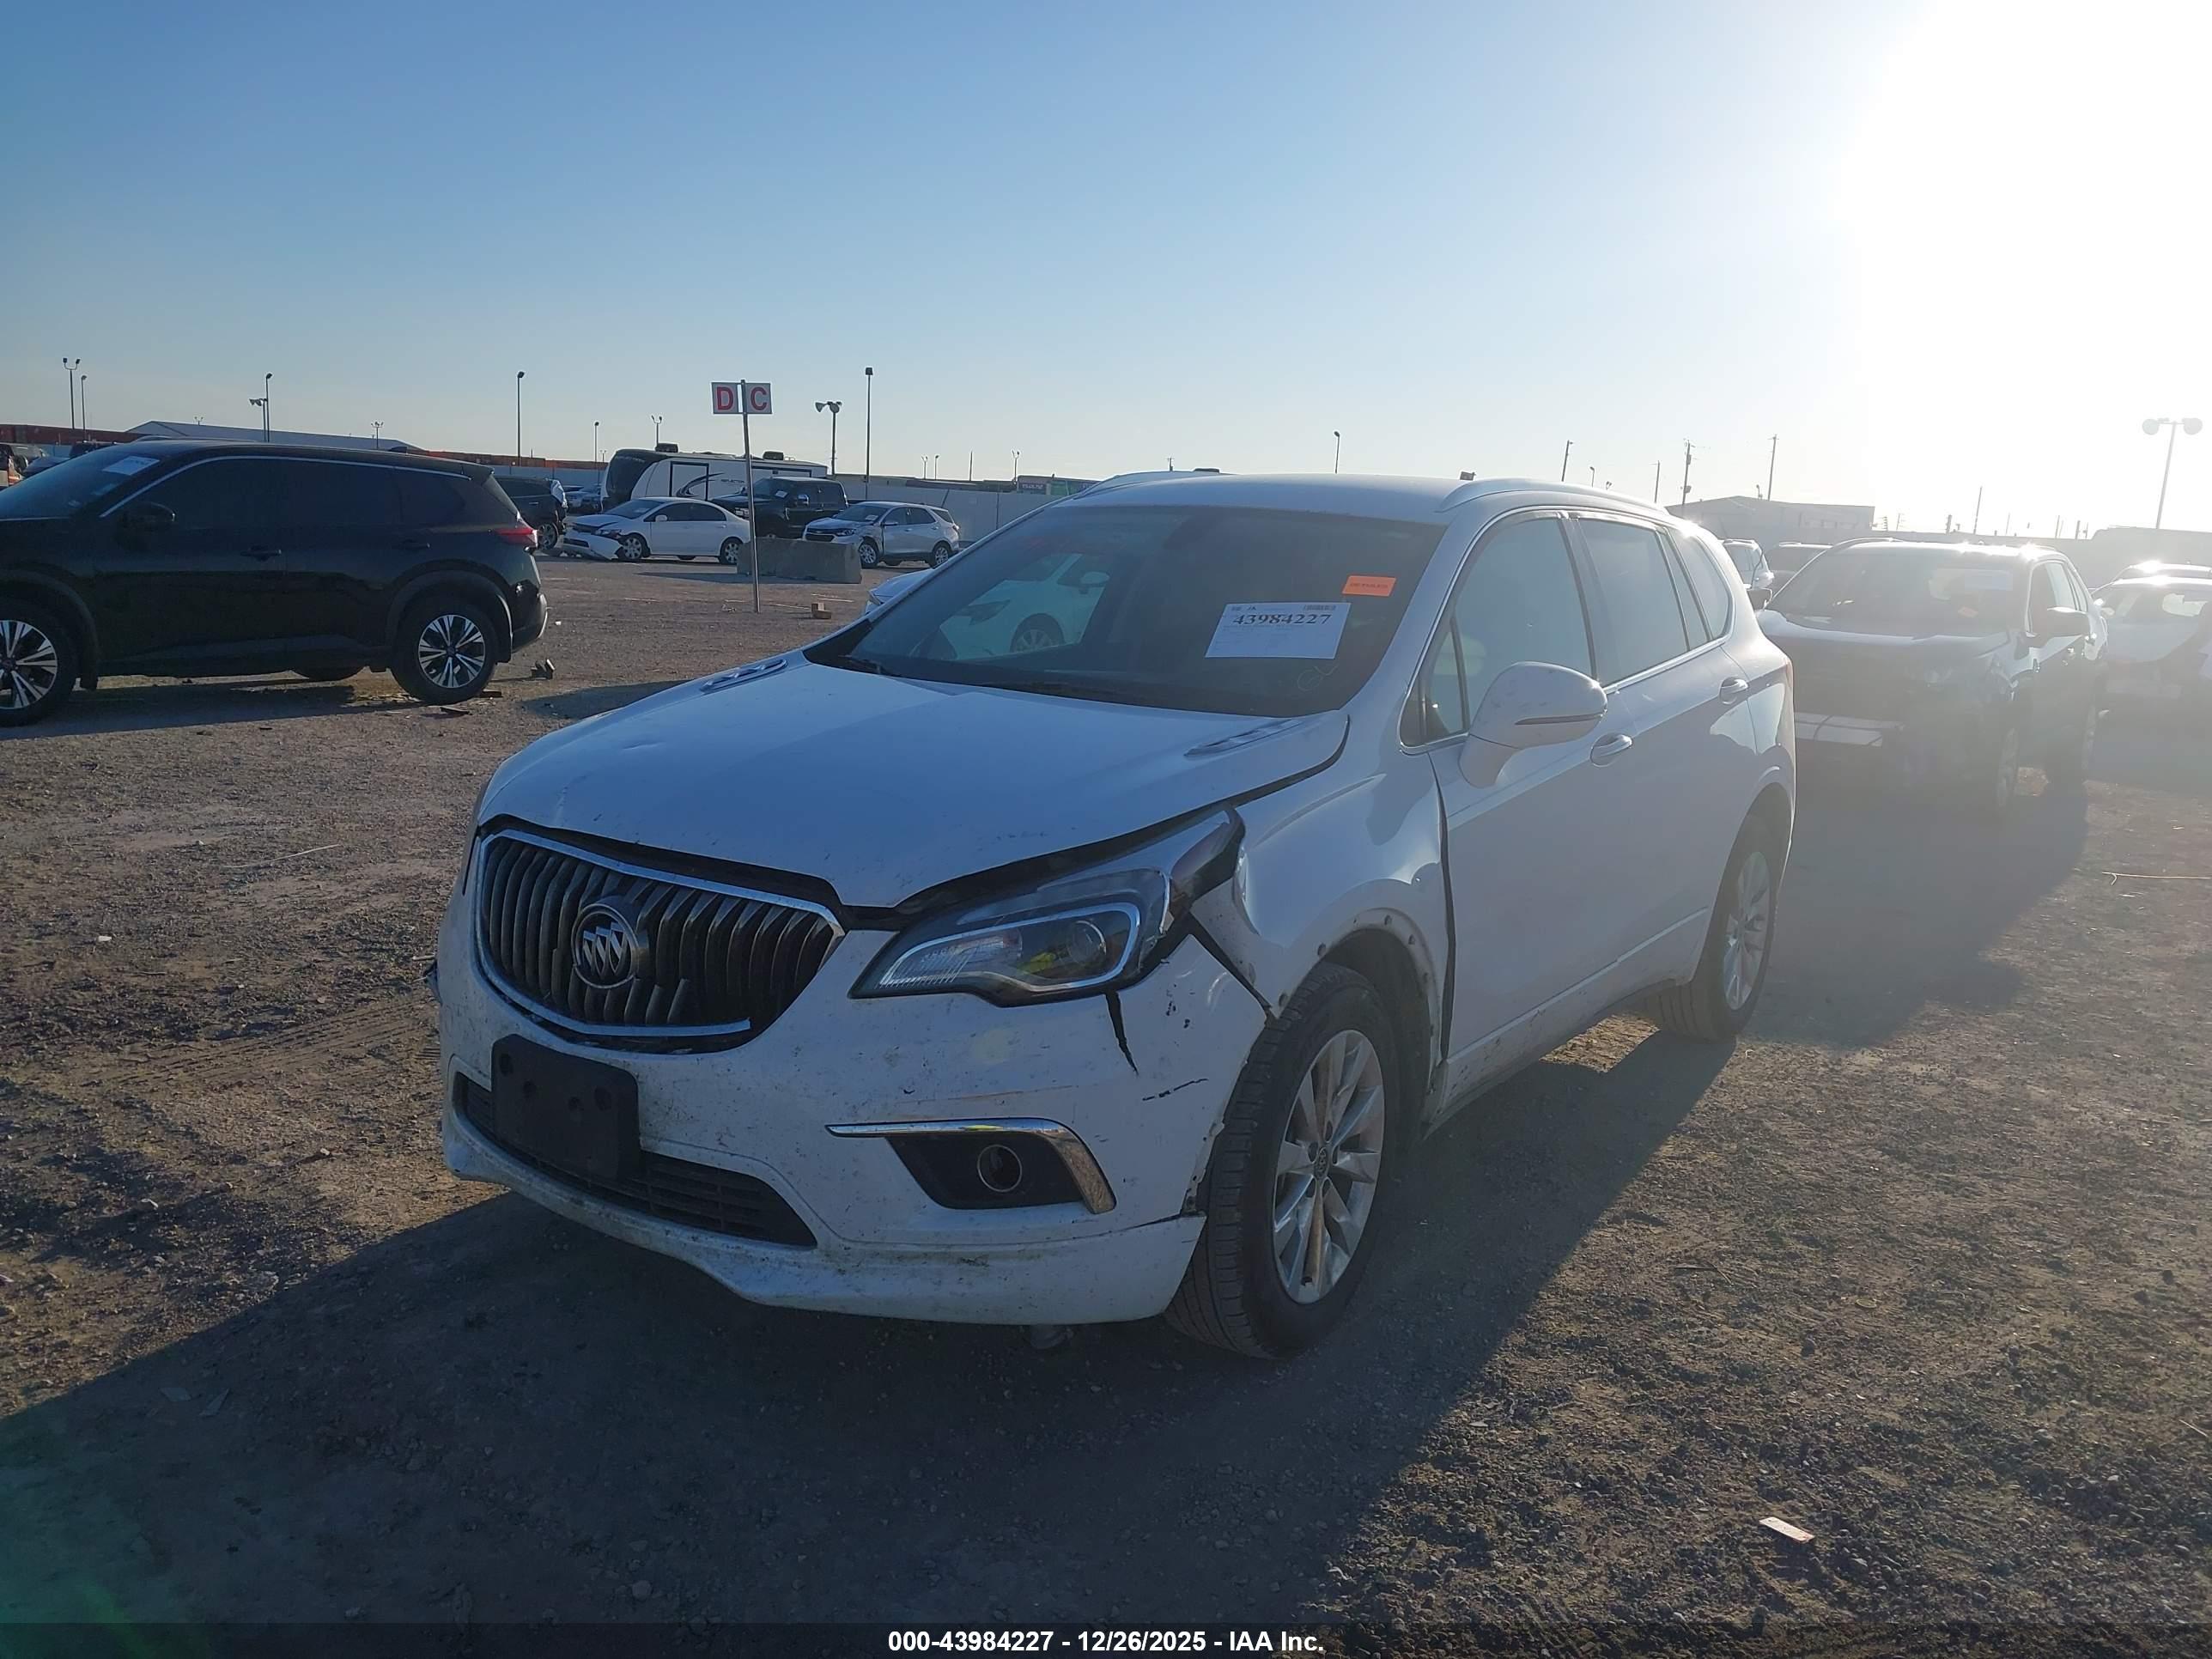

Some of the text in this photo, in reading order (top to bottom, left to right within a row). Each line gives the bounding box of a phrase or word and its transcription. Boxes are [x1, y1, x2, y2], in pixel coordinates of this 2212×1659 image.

[716, 386, 768, 410] D C
[1232, 613, 1333, 625] 43984227
